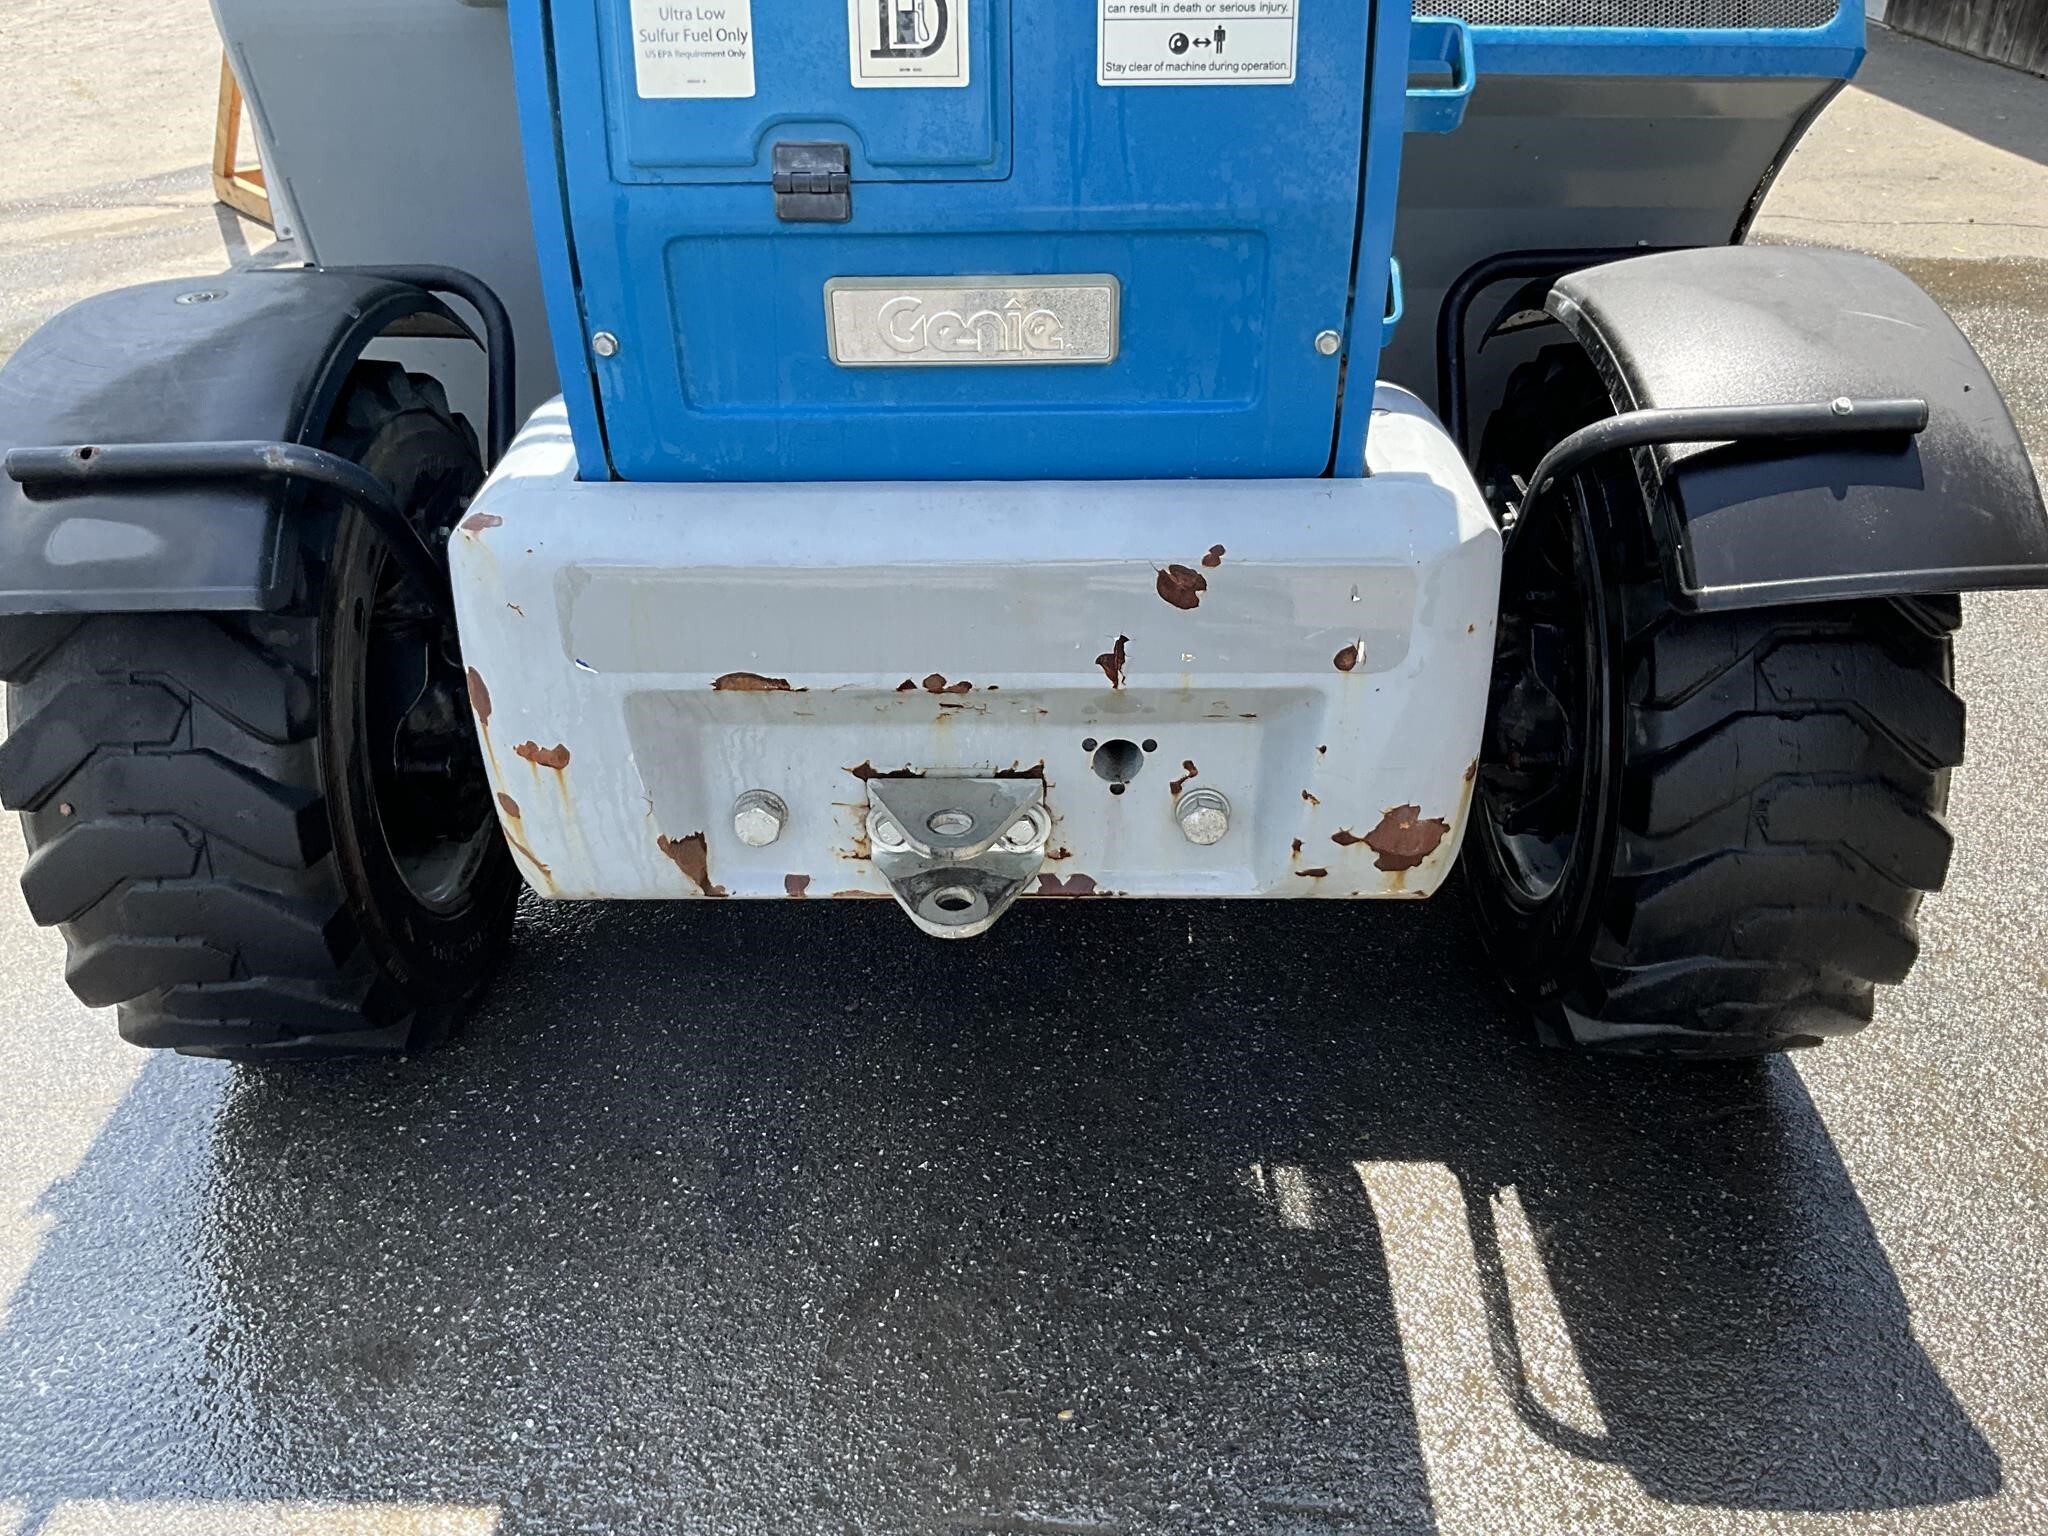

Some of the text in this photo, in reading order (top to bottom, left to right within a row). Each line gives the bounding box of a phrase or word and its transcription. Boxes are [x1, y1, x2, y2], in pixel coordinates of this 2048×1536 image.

[659, 7, 726, 21] Ultra Low
[1107, 2, 1289, 15] can result in death or serious injury.
[639, 27, 748, 45] Sulfur Fuel Only
[645, 49, 746, 61] US EPA Requirement Only
[1105, 60, 1289, 74] Stay clear of machine during operation.
[877, 295, 1064, 353] Genie
